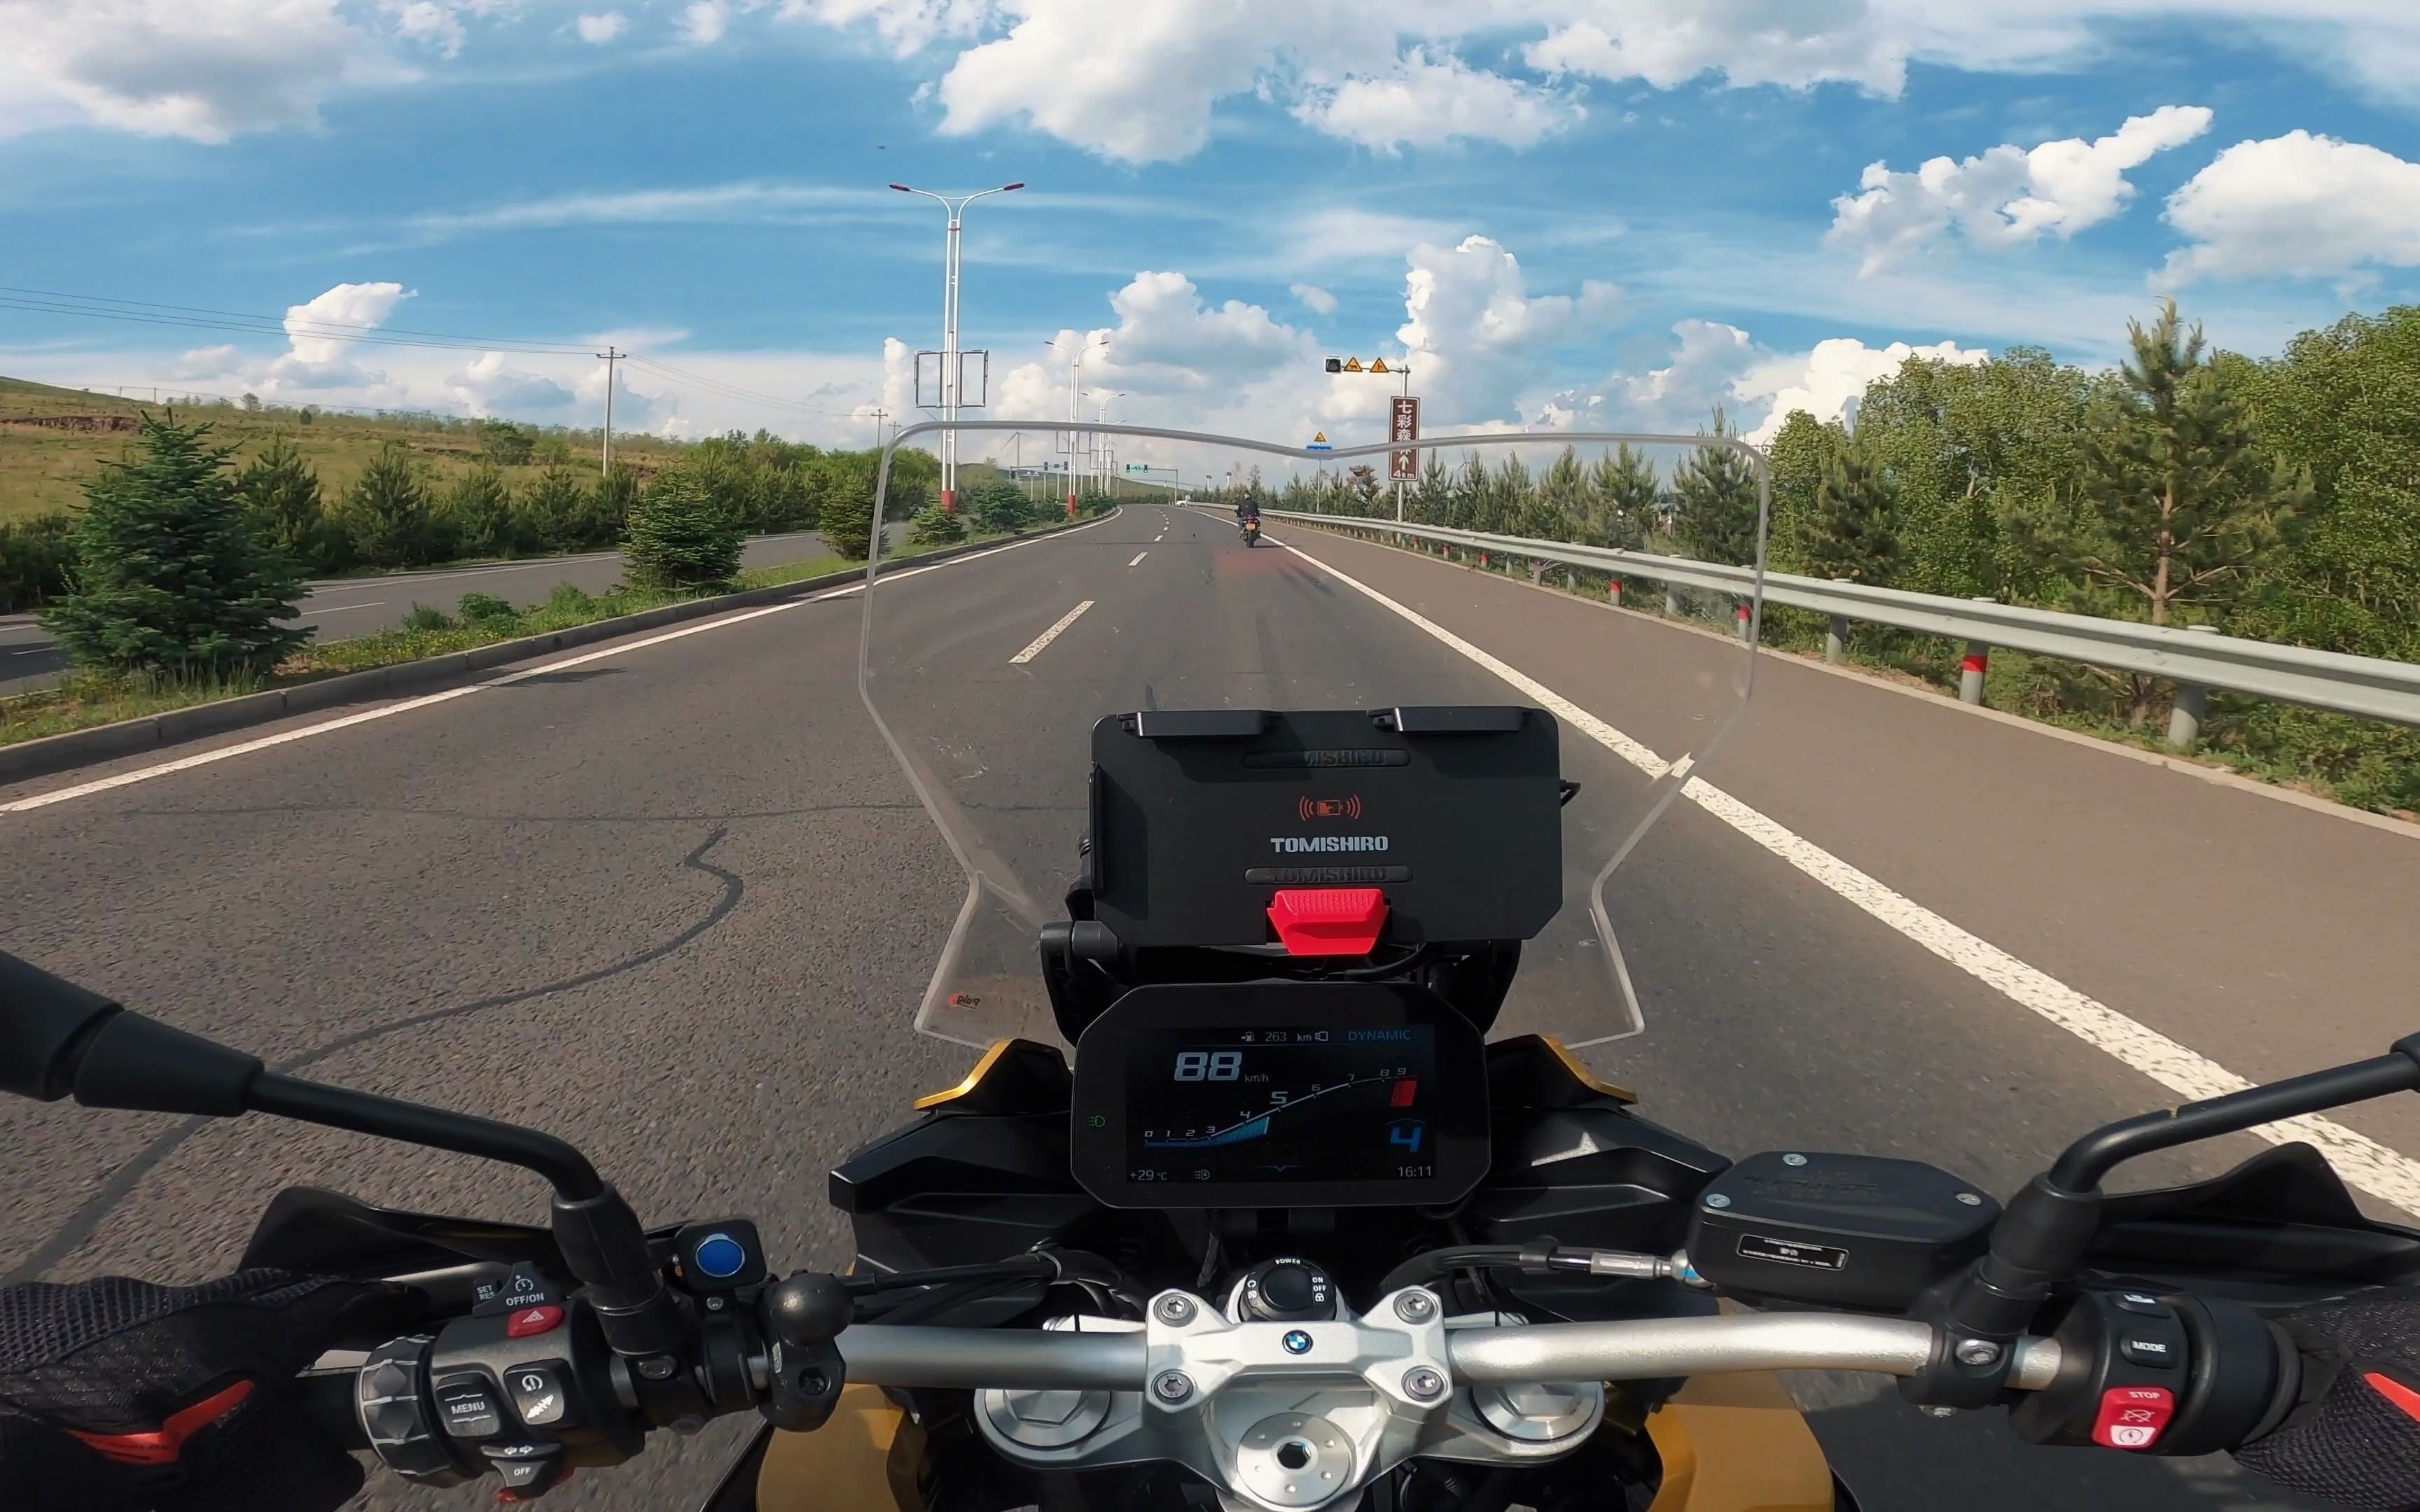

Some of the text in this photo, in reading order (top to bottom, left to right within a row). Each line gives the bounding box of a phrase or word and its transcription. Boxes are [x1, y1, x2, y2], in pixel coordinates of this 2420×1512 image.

[1270, 836, 1389, 853] TOMISHIRO
[1265, 1032, 1312, 1042] 263 km
[1349, 1030, 1411, 1041] DYNAMIC
[1174, 1052, 1269, 1083] 88 km/h
[1270, 1091, 1288, 1104] 5
[1240, 1110, 1251, 1119] 4
[1390, 1126, 1422, 1152] 4
[1129, 1170, 1154, 1181] +29
[1397, 1166, 1431, 1177] 16:11
[477, 1285, 492, 1294] SET
[479, 1292, 495, 1301] RES
[506, 1292, 545, 1306] OFF/ON
[2132, 1340, 2167, 1352] MODE
[451, 1401, 485, 1414] MENU
[514, 1467, 531, 1476] OFF
